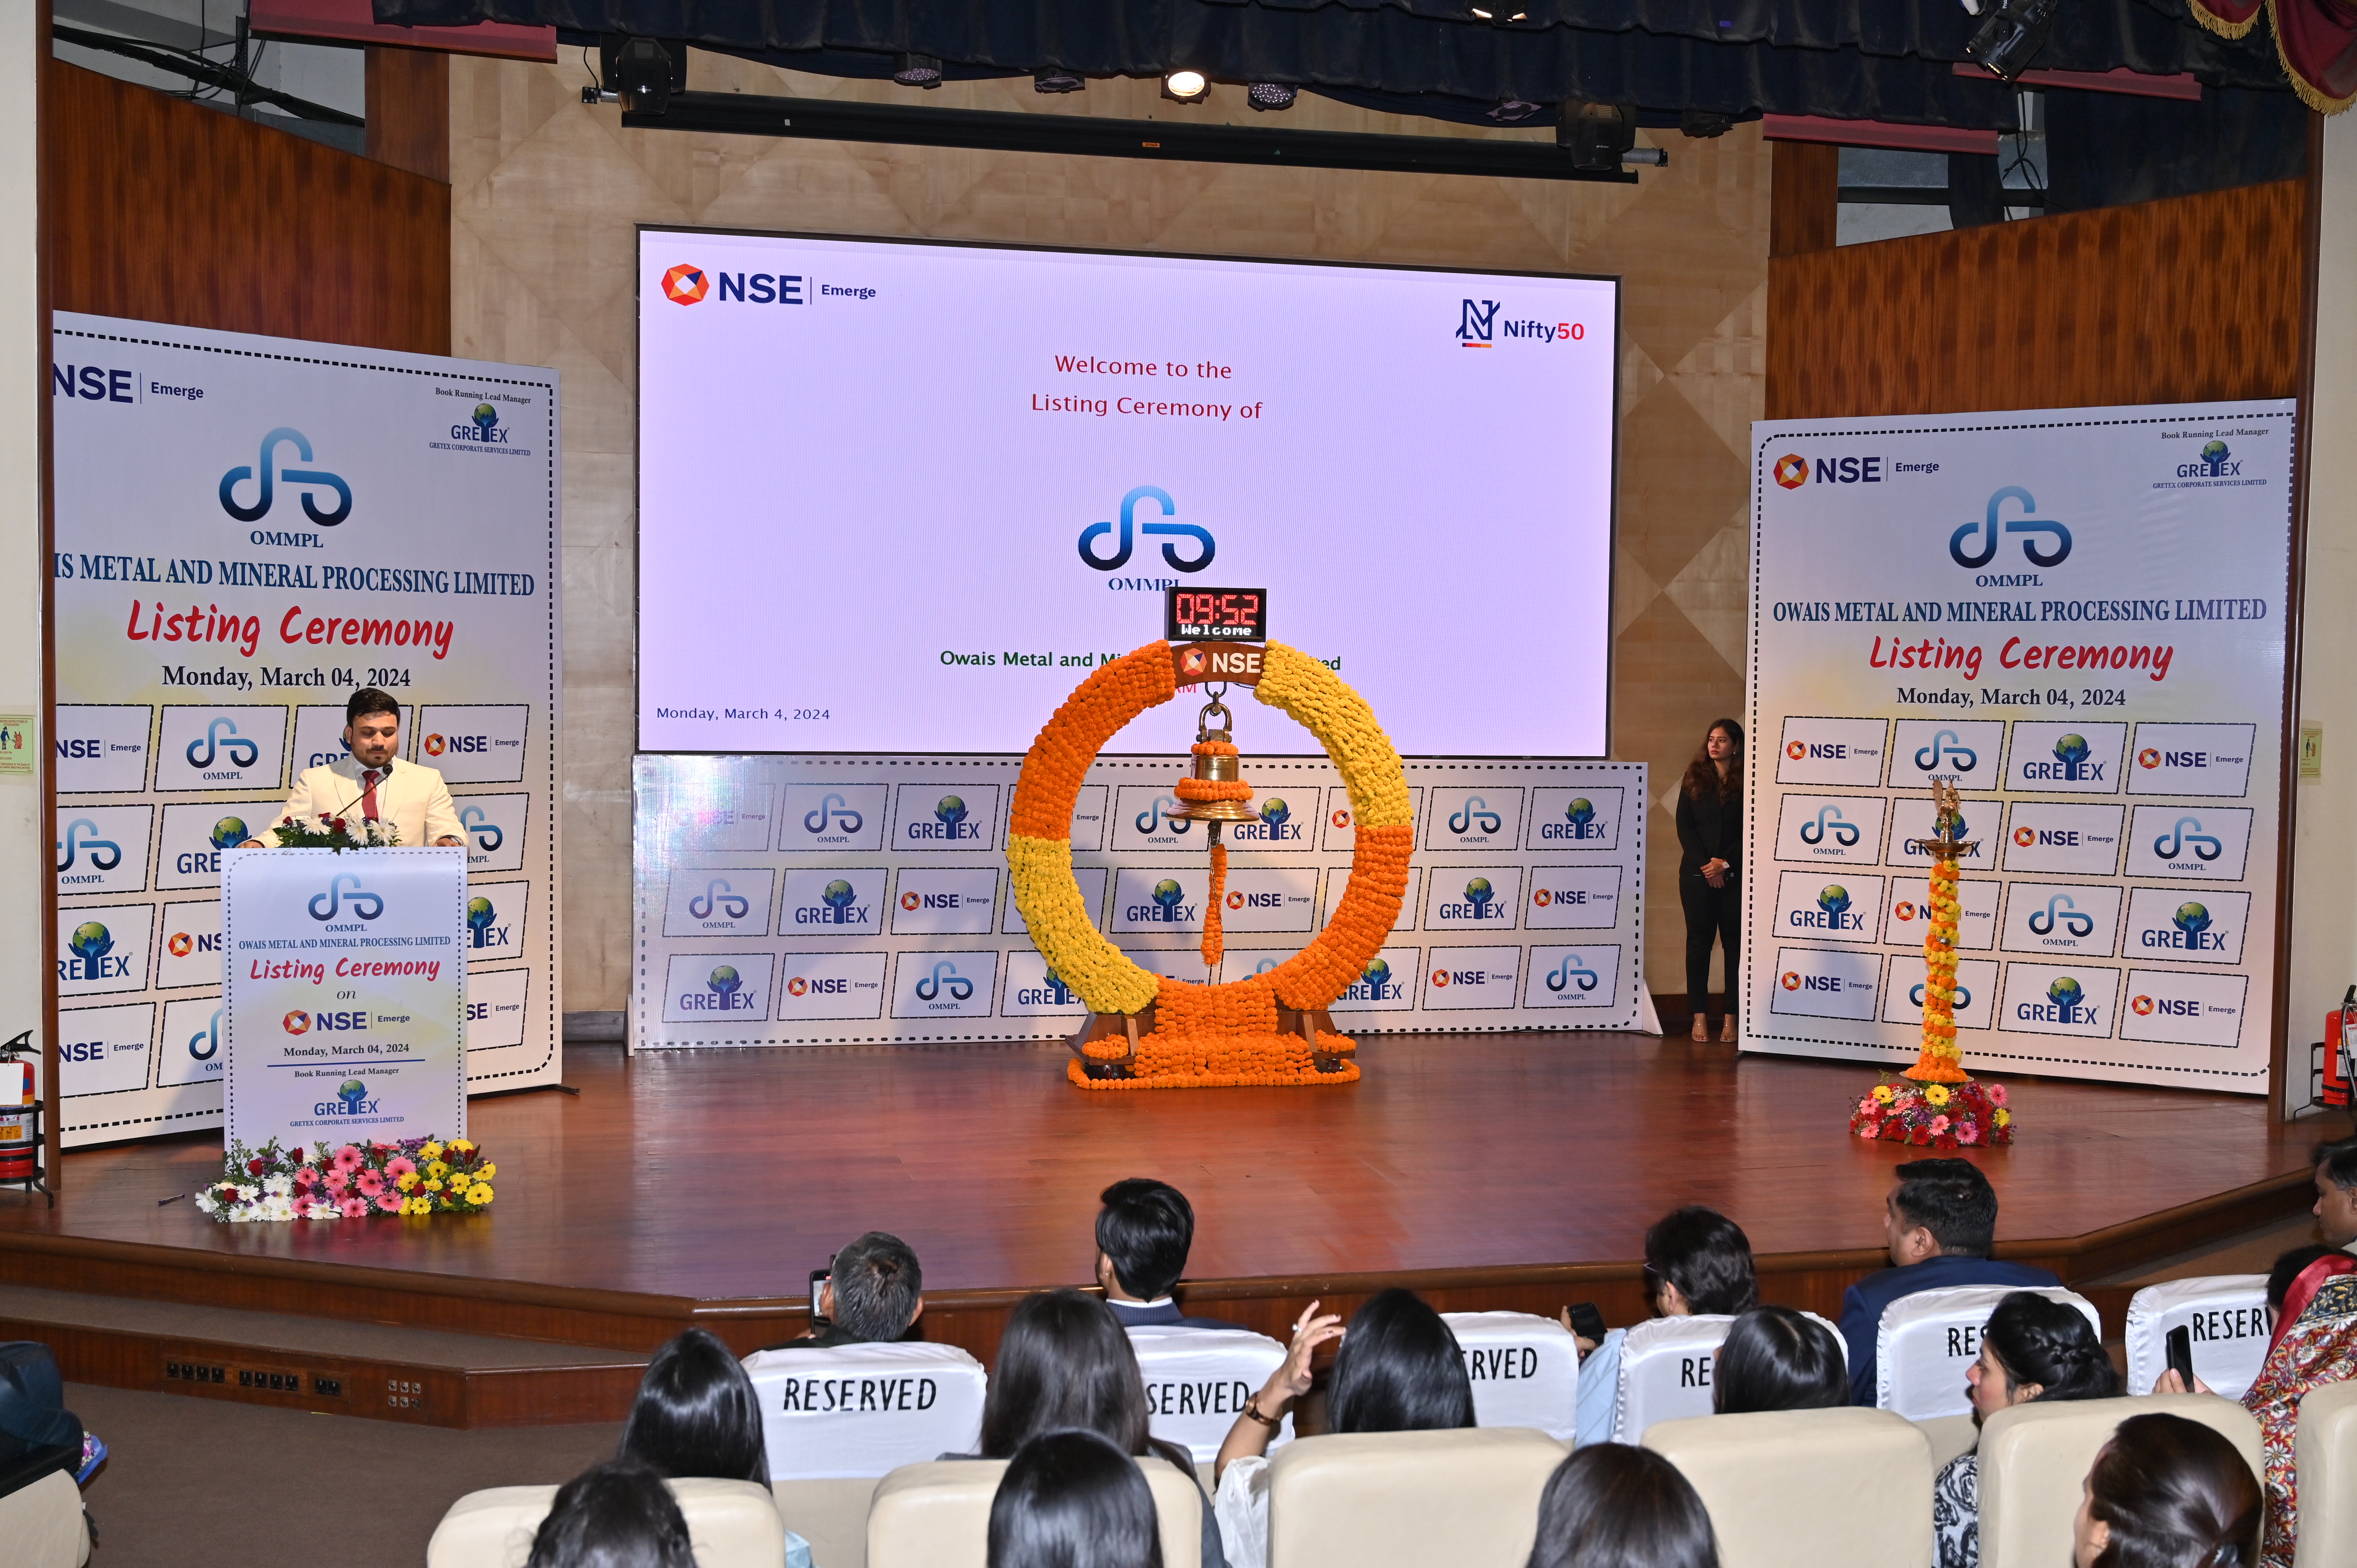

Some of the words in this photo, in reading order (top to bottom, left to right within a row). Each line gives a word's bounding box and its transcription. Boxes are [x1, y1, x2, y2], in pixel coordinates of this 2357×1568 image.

[720, 272, 803, 304] NSE
[822, 284, 876, 299] Emerge
[1504, 320, 1584, 343] Nifty50
[1055, 355, 1157, 375] Welcome
[1166, 362, 1187, 376] to
[1197, 361, 1231, 378] the
[53, 363, 133, 403] NSE
[152, 382, 203, 400] Emerge
[436, 388, 453, 396] Book
[455, 390, 483, 401] Running
[503, 394, 531, 404] Manager
[1033, 394, 1107, 416] Listing
[1117, 397, 1232, 421] Ceremony
[1240, 402, 1263, 418] of
[451, 424, 508, 443] GRETEX
[1816, 457, 1880, 483] NSE
[1896, 463, 1939, 473] Emerge
[2176, 460, 2241, 478] GRETEX
[251, 531, 323, 547] OMMPL
[80, 554, 161, 582] METAL
[166, 559, 212, 584] AND
[219, 562, 317, 588] MINERAL
[322, 566, 449, 593] PROCESSING
[454, 572, 534, 595] LIMITED
[1976, 575, 2042, 587] OMMPL
[1177, 594, 1259, 625] 09:52
[1774, 602, 1830, 621] OWAIS
[1835, 602, 1898, 621] METAL
[1902, 602, 1942, 622] AND
[1947, 602, 2036, 622] MINERAL
[2041, 600, 2170, 621] PROCESSING
[2175, 599, 2266, 620] LIMITED
[127, 600, 260, 657] Listing
[280, 606, 453, 660] Ceremony
[1181, 624, 1252, 636] Welcome
[941, 651, 995, 665] Owais
[1004, 652, 1052, 666] Metal
[1060, 652, 1092, 667] and
[1212, 653, 1261, 673] NSE
[1870, 636, 1982, 680] Listing
[2000, 637, 2173, 681] Ceremony
[162, 666, 252, 690] Monday,
[260, 667, 325, 686] March
[332, 668, 359, 691] 04,
[367, 668, 410, 687] 2024
[1896, 688, 1973, 708] Monday,
[1981, 689, 2041, 705] March
[2047, 689, 2074, 710] 04,
[2081, 689, 2126, 705] 2024
[657, 708, 718, 721] Monday,
[725, 708, 767, 719] March
[774, 709, 786, 721] 4,
[794, 709, 830, 719] 2024
[57, 740, 101, 758] NSE
[111, 744, 141, 752] Emerge
[450, 736, 487, 752] NSE
[1811, 744, 1846, 759] NSE
[2166, 752, 2206, 767] NSE
[2023, 762, 2104, 780] GRETEX
[908, 821, 979, 839] GRETEX
[1234, 823, 1301, 840] GRETEX
[1541, 823, 1606, 839] GRETEX
[2040, 830, 2078, 846] NSE
[62, 875, 104, 884] OMMPL
[924, 894, 959, 908] NSE
[1249, 893, 1281, 907] NSE
[1555, 891, 1586, 904] NSE
[795, 906, 868, 923] GRETEX
[1126, 904, 1195, 922] GRETEX
[1439, 902, 1504, 919] GRETEX
[1790, 910, 1864, 930] GRETEX
[239, 941, 266, 949] OWAIS
[269, 940, 298, 948] METAL
[300, 939, 317, 948] AND
[320, 939, 358, 947] MINERAL
[360, 938, 413, 946] PROCESSING
[415, 937, 450, 945] LIMITED
[2141, 929, 2226, 951] GRETEX
[58, 955, 130, 980] RETEX
[251, 959, 324, 985] Listing
[336, 957, 440, 981] Ceremony
[812, 979, 847, 993] NSE
[1454, 971, 1485, 984] NSE
[1805, 976, 1841, 992] NSE
[337, 991, 356, 999] on
[680, 992, 754, 1010] GRETEX
[468, 1003, 488, 1021] SE
[2017, 1003, 2097, 1024] GRETEX
[2159, 999, 2199, 1016] NSE
[317, 1012, 367, 1031] NSE
[59, 1042, 104, 1063] NSE
[284, 1047, 327, 1057] Monday,
[331, 1045, 364, 1054] March
[368, 1045, 382, 1055] 04,
[386, 1044, 409, 1052] 2024
[314, 1100, 379, 1116] GRETEX
[2193, 1307, 2271, 1342] RESER
[784, 1379, 936, 1411] RESERVED
[1147, 1381, 1249, 1415] SERVED
